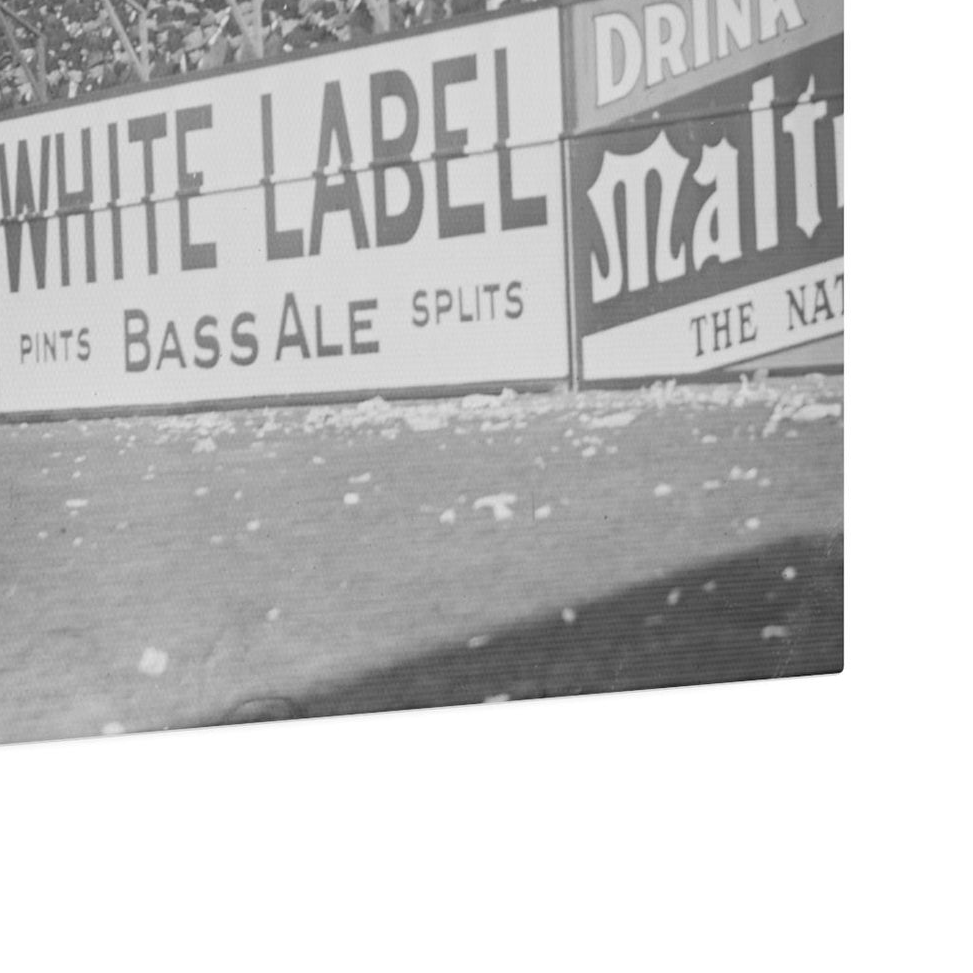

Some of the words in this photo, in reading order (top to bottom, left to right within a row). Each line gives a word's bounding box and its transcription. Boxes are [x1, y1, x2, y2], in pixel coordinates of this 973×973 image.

[260, 47, 548, 262] LABEL
[19, 327, 92, 365] PINTS
[410, 280, 524, 327] SPLITS
[690, 301, 758, 357] THE
[785, 272, 844, 331] NAT
